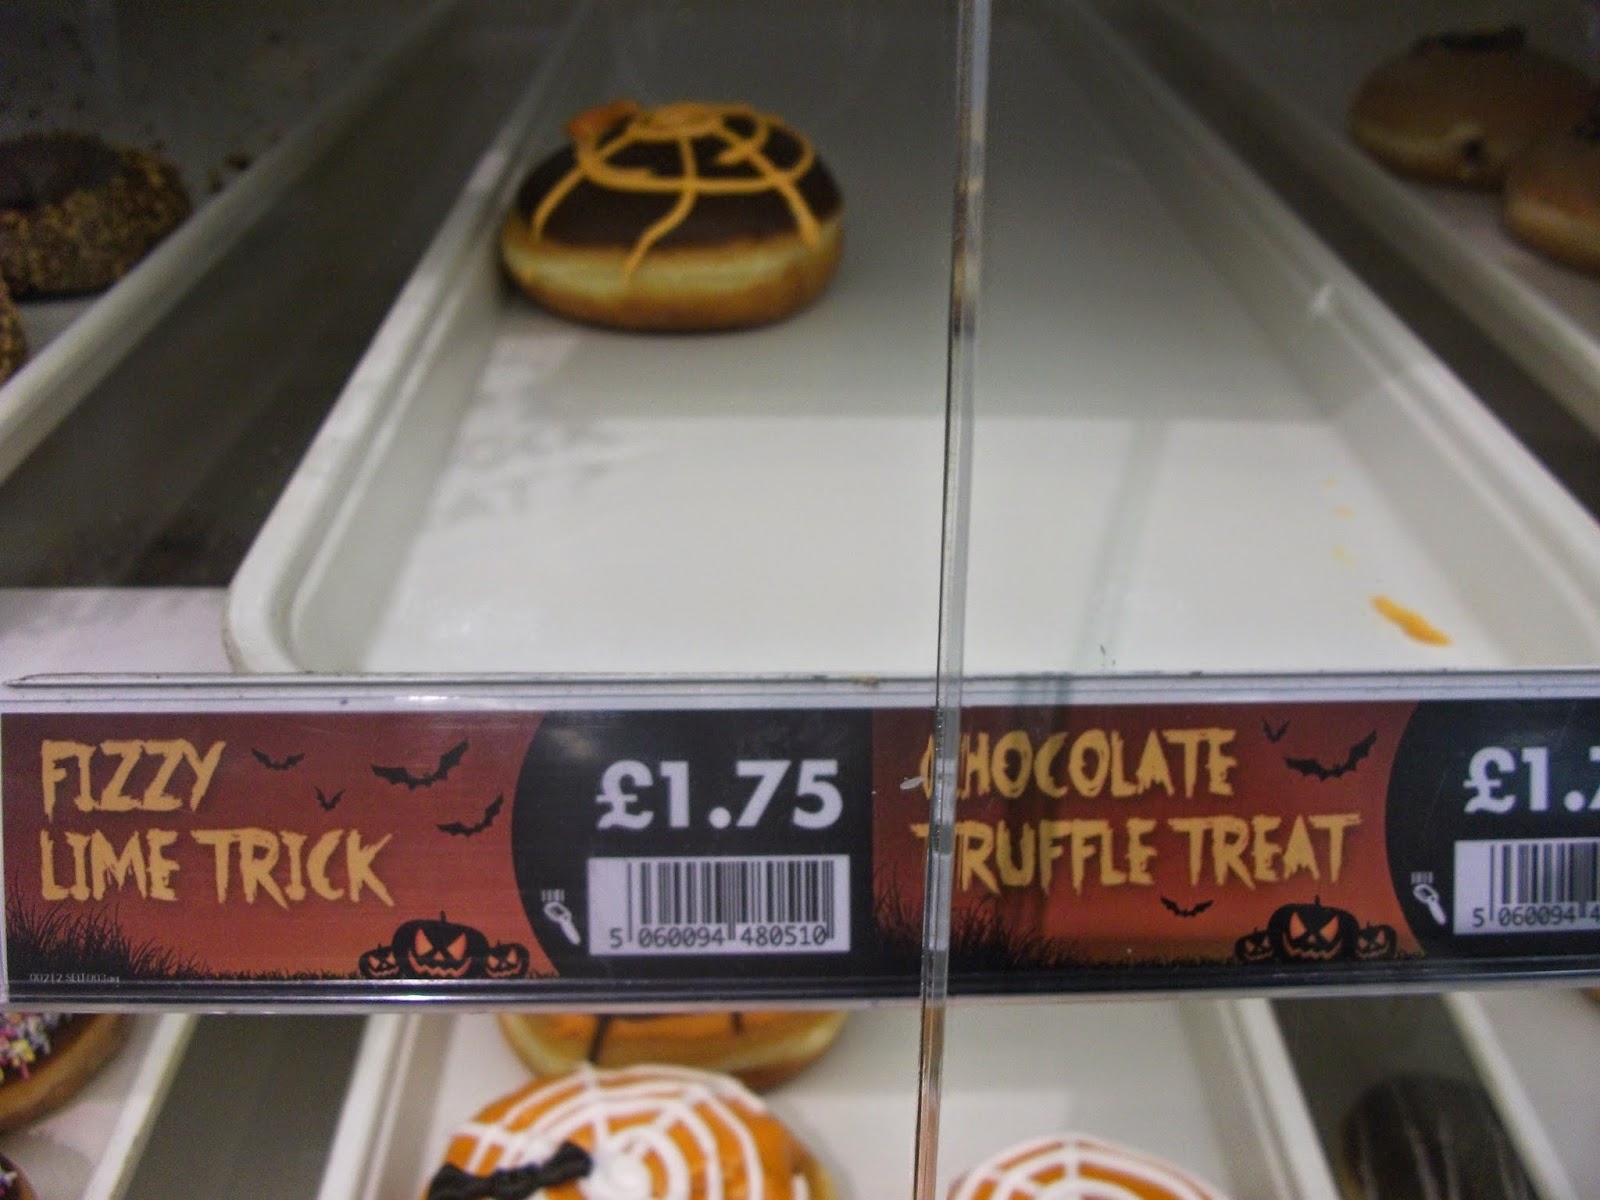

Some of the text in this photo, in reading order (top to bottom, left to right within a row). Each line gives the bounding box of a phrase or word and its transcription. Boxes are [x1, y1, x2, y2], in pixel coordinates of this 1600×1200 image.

[40, 738, 226, 822] FIZZY
[595, 759, 844, 830] £1.75
[1462, 746, 1600, 814] £1.
[39, 826, 395, 911] LIME TRICK
[1168, 814, 1363, 890] TREAT
[609, 924, 828, 948] 5 060094 480510
[1472, 907, 1485, 928] 5
